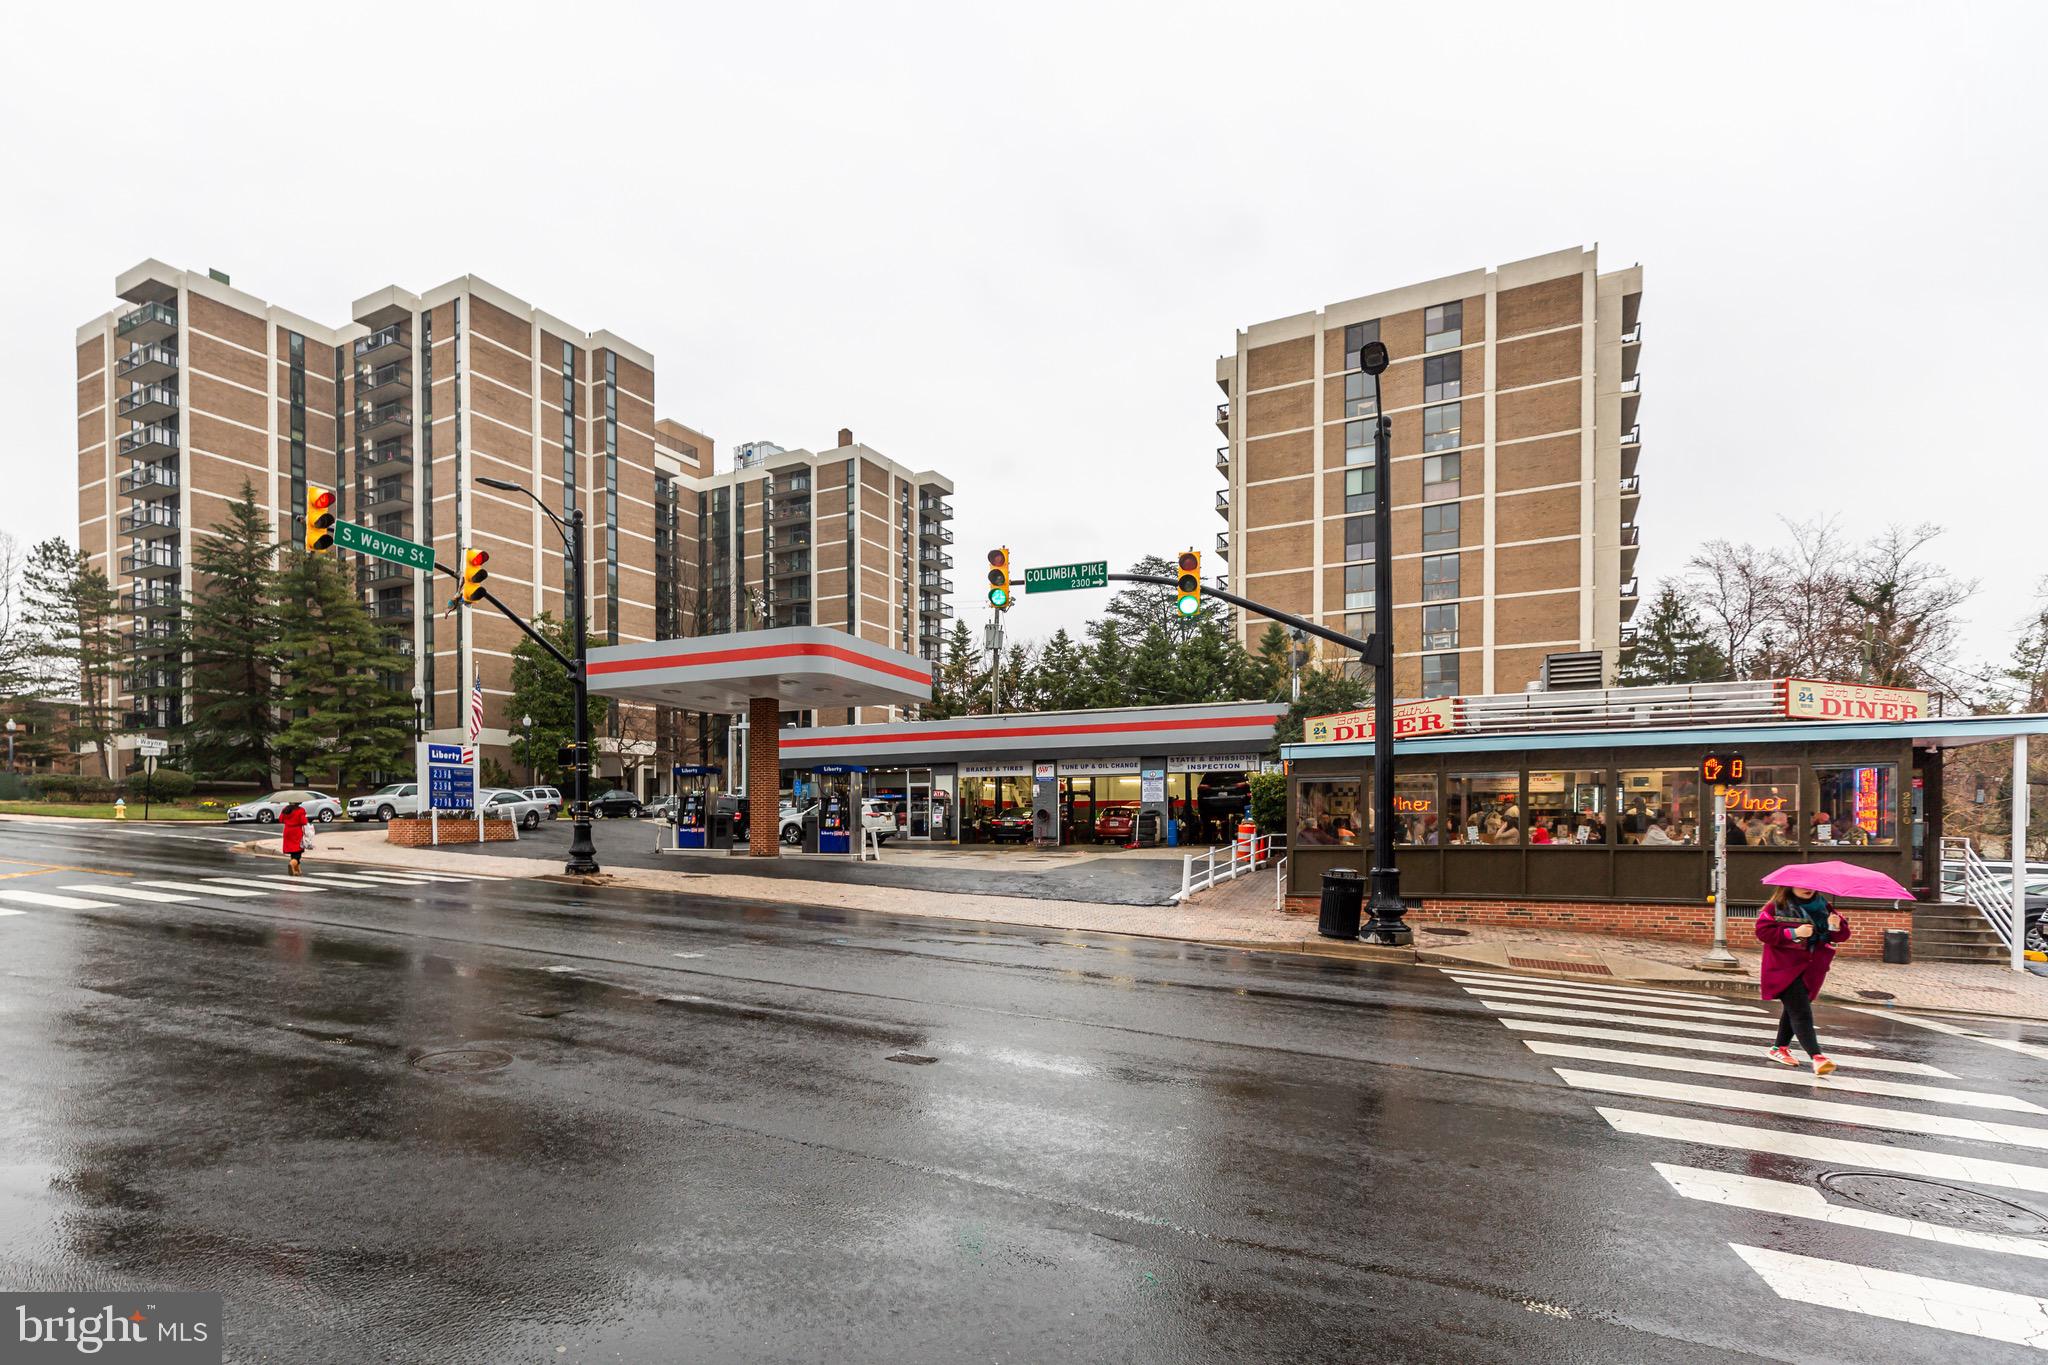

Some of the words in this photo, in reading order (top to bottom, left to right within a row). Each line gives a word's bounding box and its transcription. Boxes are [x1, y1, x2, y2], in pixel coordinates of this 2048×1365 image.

[342, 528, 355, 543] S.
[361, 532, 404, 557] Wayne
[410, 548, 427, 564] St.
[1026, 566, 1077, 582] COLUMBIA
[1081, 563, 1104, 577] PIKE
[1071, 578, 1090, 588] 2300
[1798, 691, 1814, 702] 24
[1819, 697, 1920, 721] DINER
[1335, 715, 1350, 725] Bob
[1313, 726, 1327, 735] 24
[431, 749, 460, 761] Liberty
[1208, 753, 1257, 762] EMISSIONS
[965, 765, 993, 773] BRAKES
[1111, 761, 1138, 769] CHANGE
